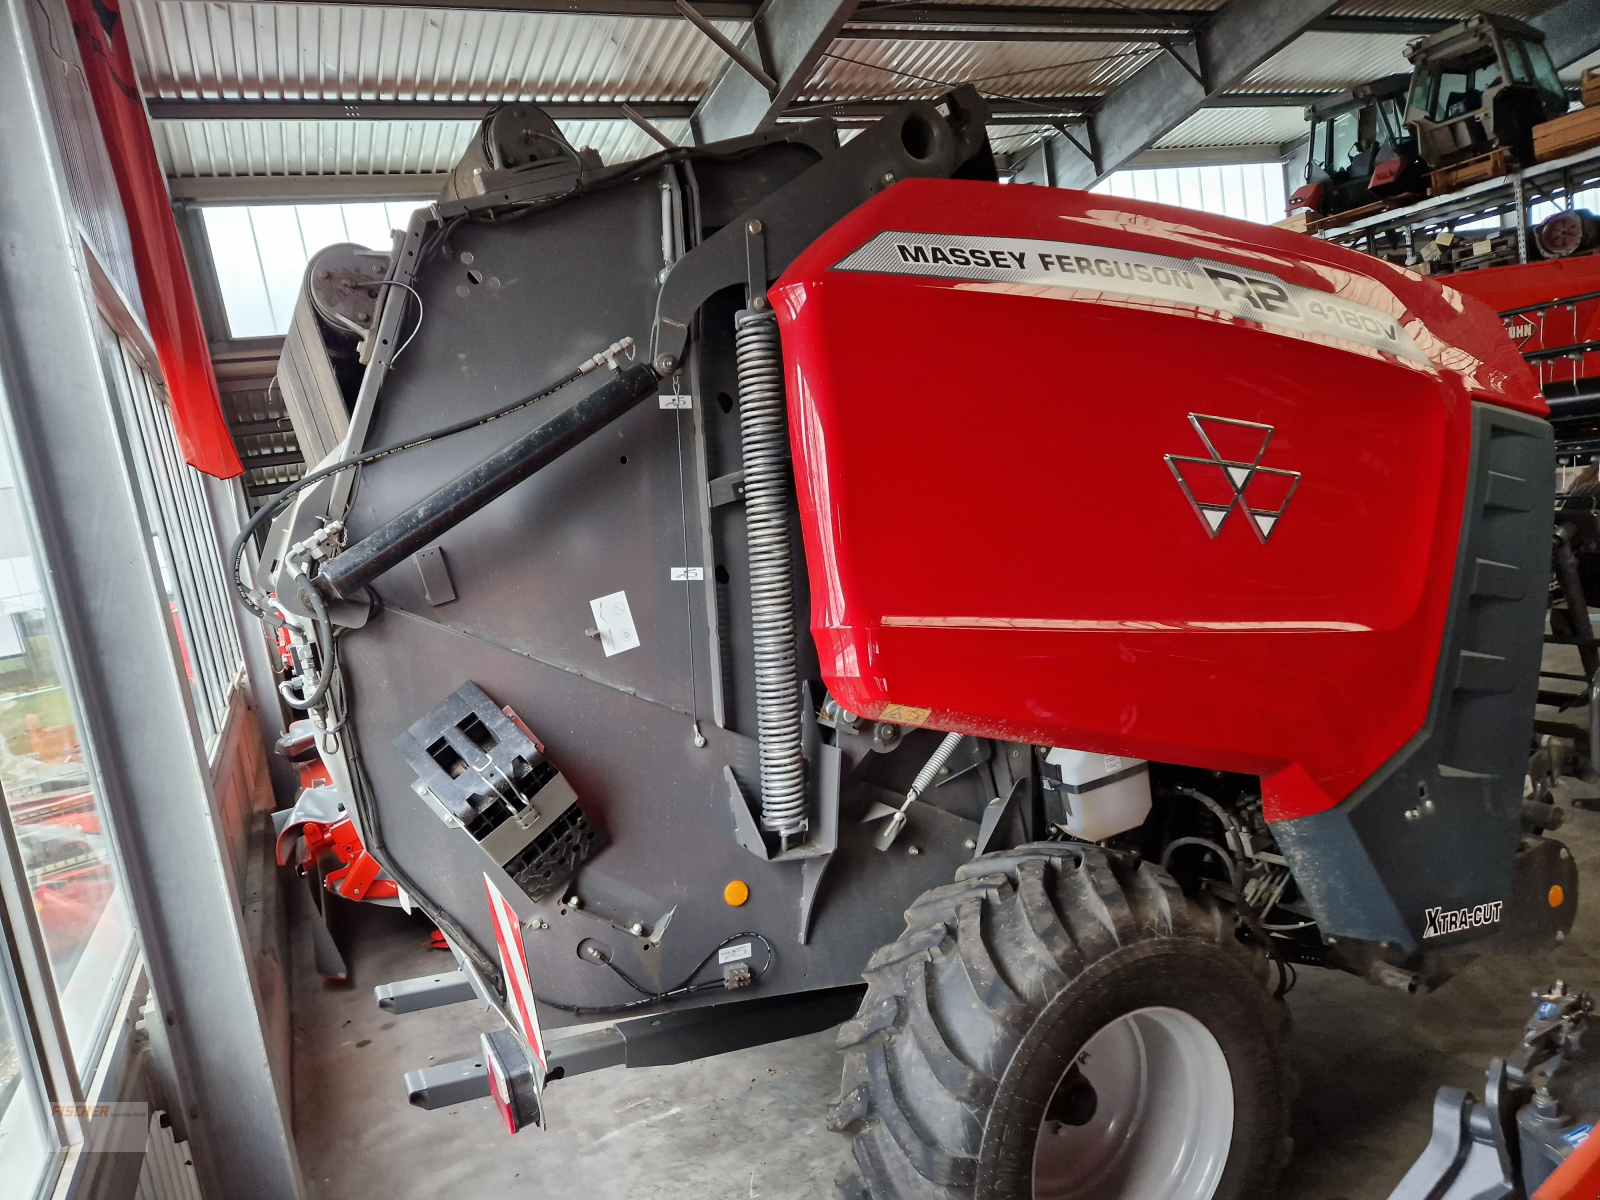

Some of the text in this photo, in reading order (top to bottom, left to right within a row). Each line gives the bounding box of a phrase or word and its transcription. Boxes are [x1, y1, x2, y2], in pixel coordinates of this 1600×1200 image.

[896, 244, 1026, 270] MASSEY
[1037, 252, 1194, 290] FERGUSON
[1307, 301, 1397, 341] 4180V
[1507, 323, 1532, 339] UHN
